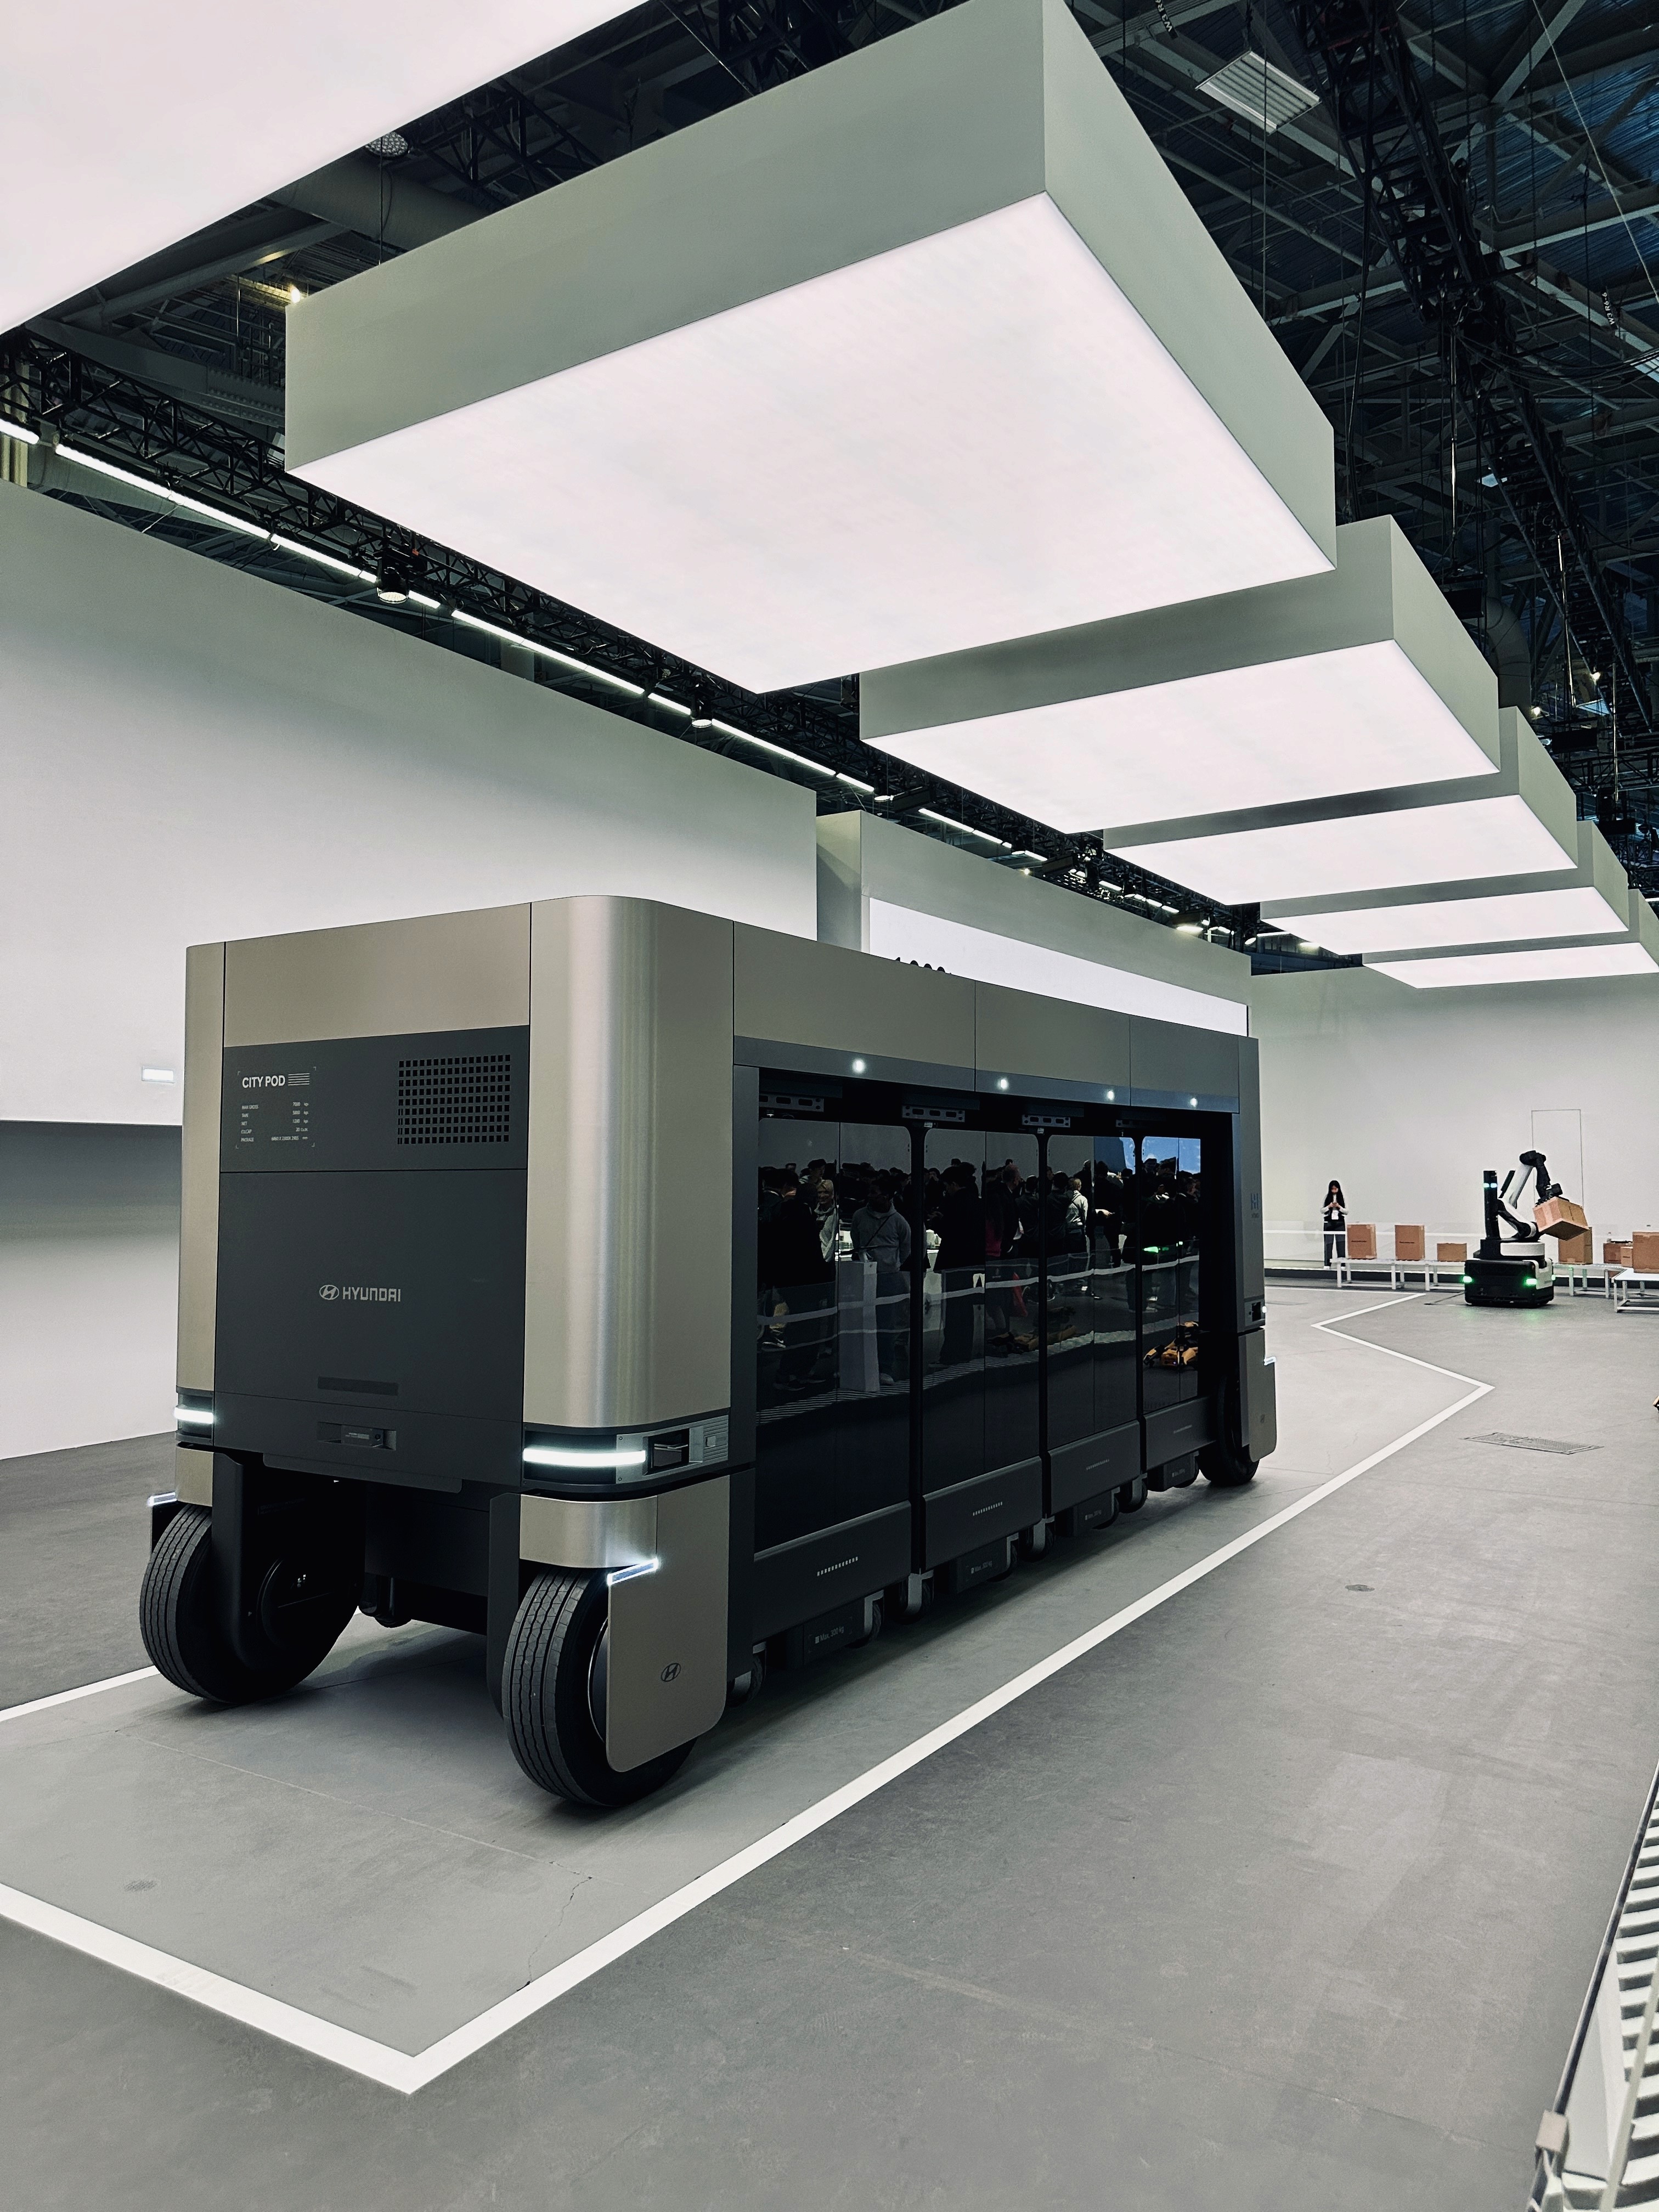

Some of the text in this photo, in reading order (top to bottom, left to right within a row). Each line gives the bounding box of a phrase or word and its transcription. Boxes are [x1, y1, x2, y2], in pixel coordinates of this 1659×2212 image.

[1601, 292, 1616, 325] W3 R6-6
[242, 1075, 286, 1088] CITY POD
[342, 1286, 401, 1302] HYUNDAI
